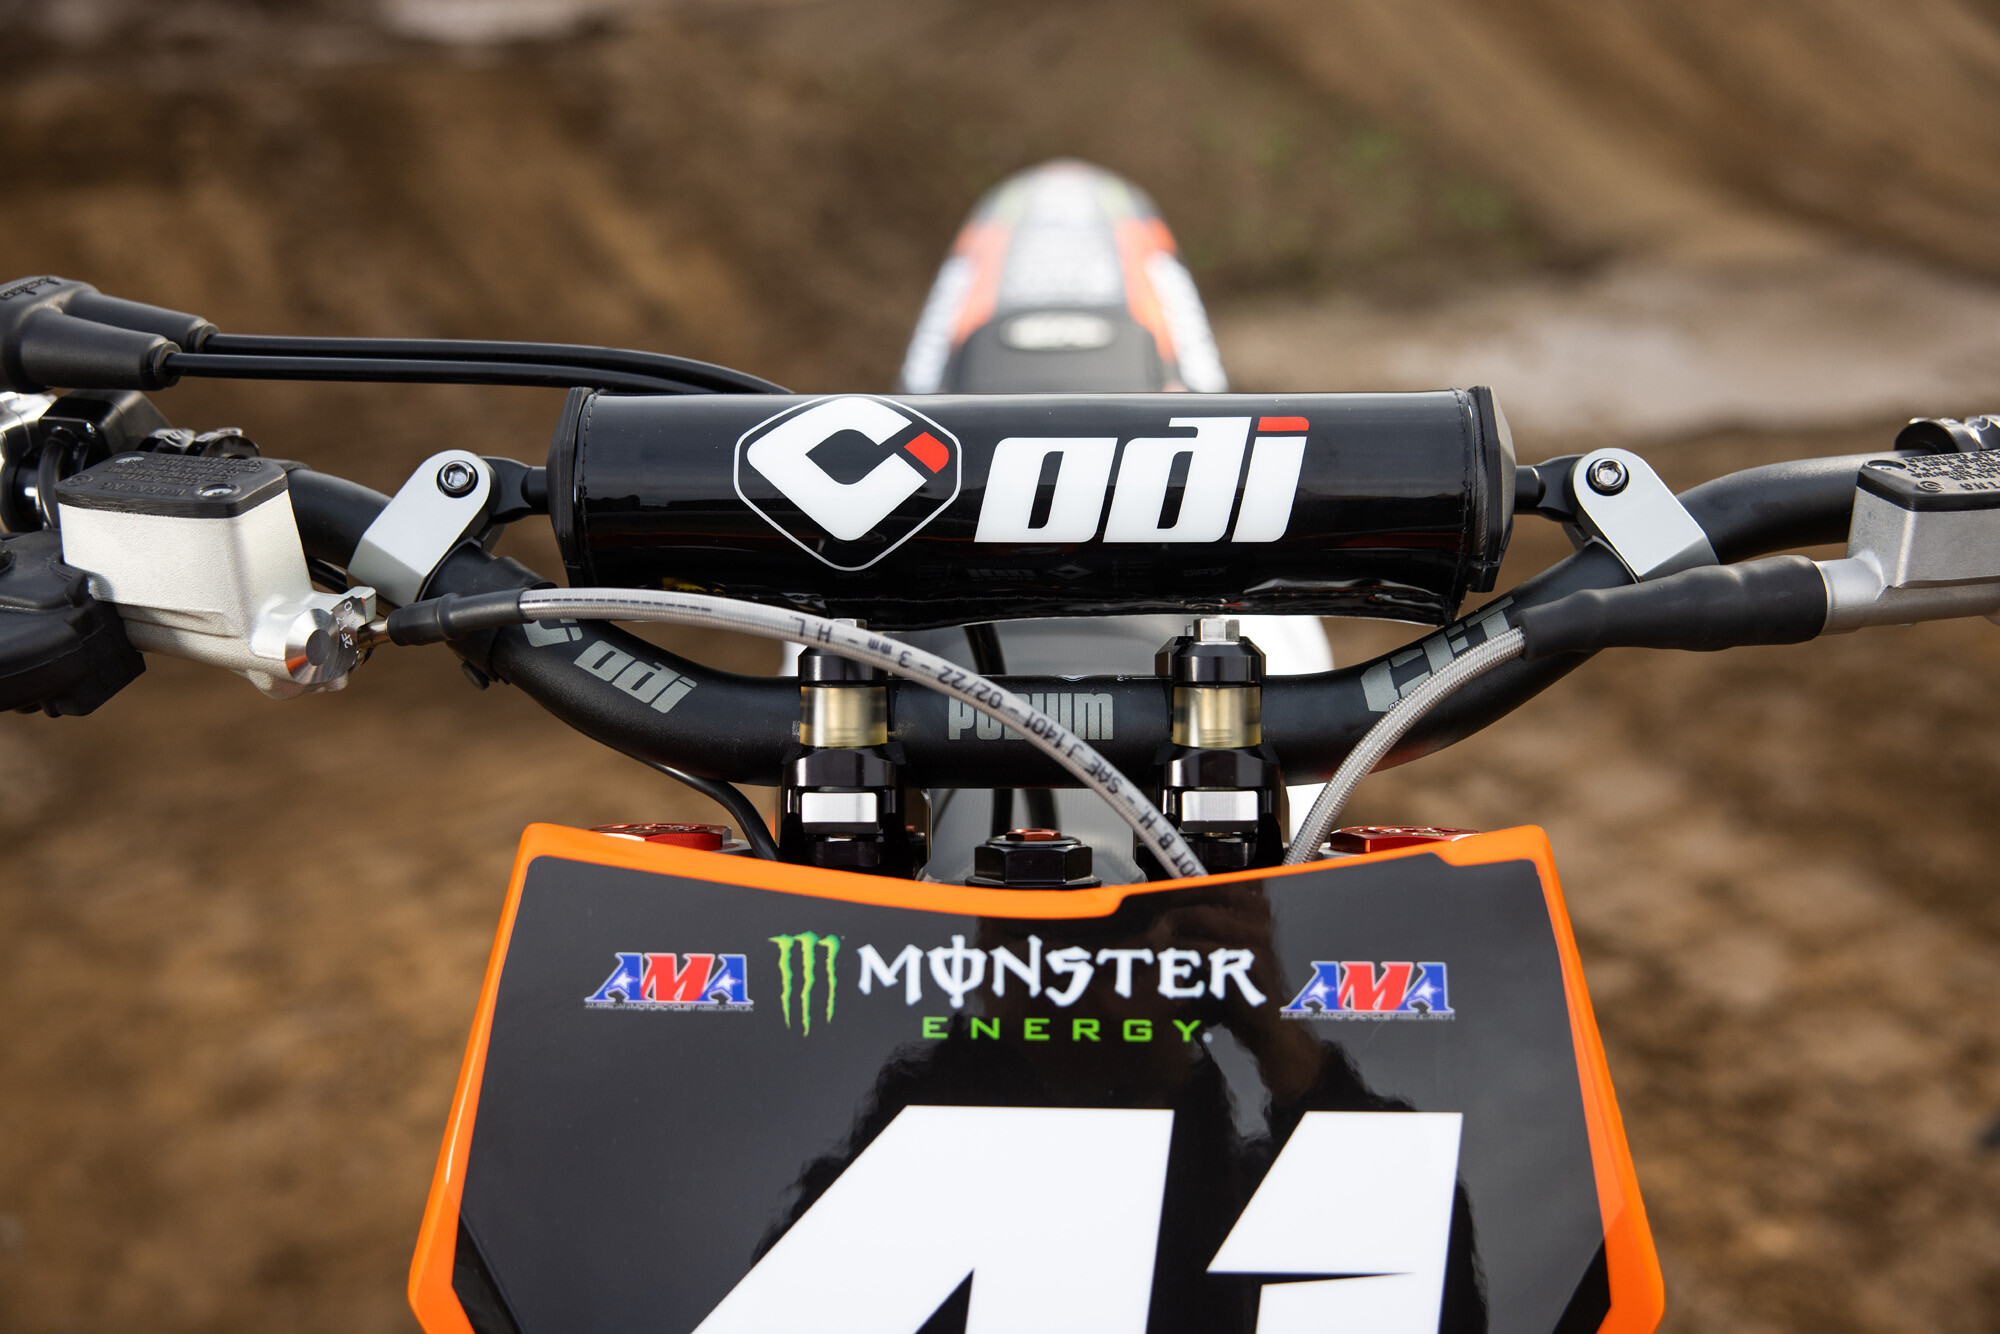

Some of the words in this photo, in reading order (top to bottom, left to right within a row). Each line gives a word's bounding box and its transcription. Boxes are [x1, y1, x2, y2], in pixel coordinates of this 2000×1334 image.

[974, 416, 1311, 544] odi
[573, 640, 697, 714] odi
[898, 651, 913, 668] 3
[937, 665, 1004, 709] 02/22
[1084, 755, 1123, 794] SAE
[584, 952, 754, 1005] AMA
[1279, 960, 1456, 1013] AMA
